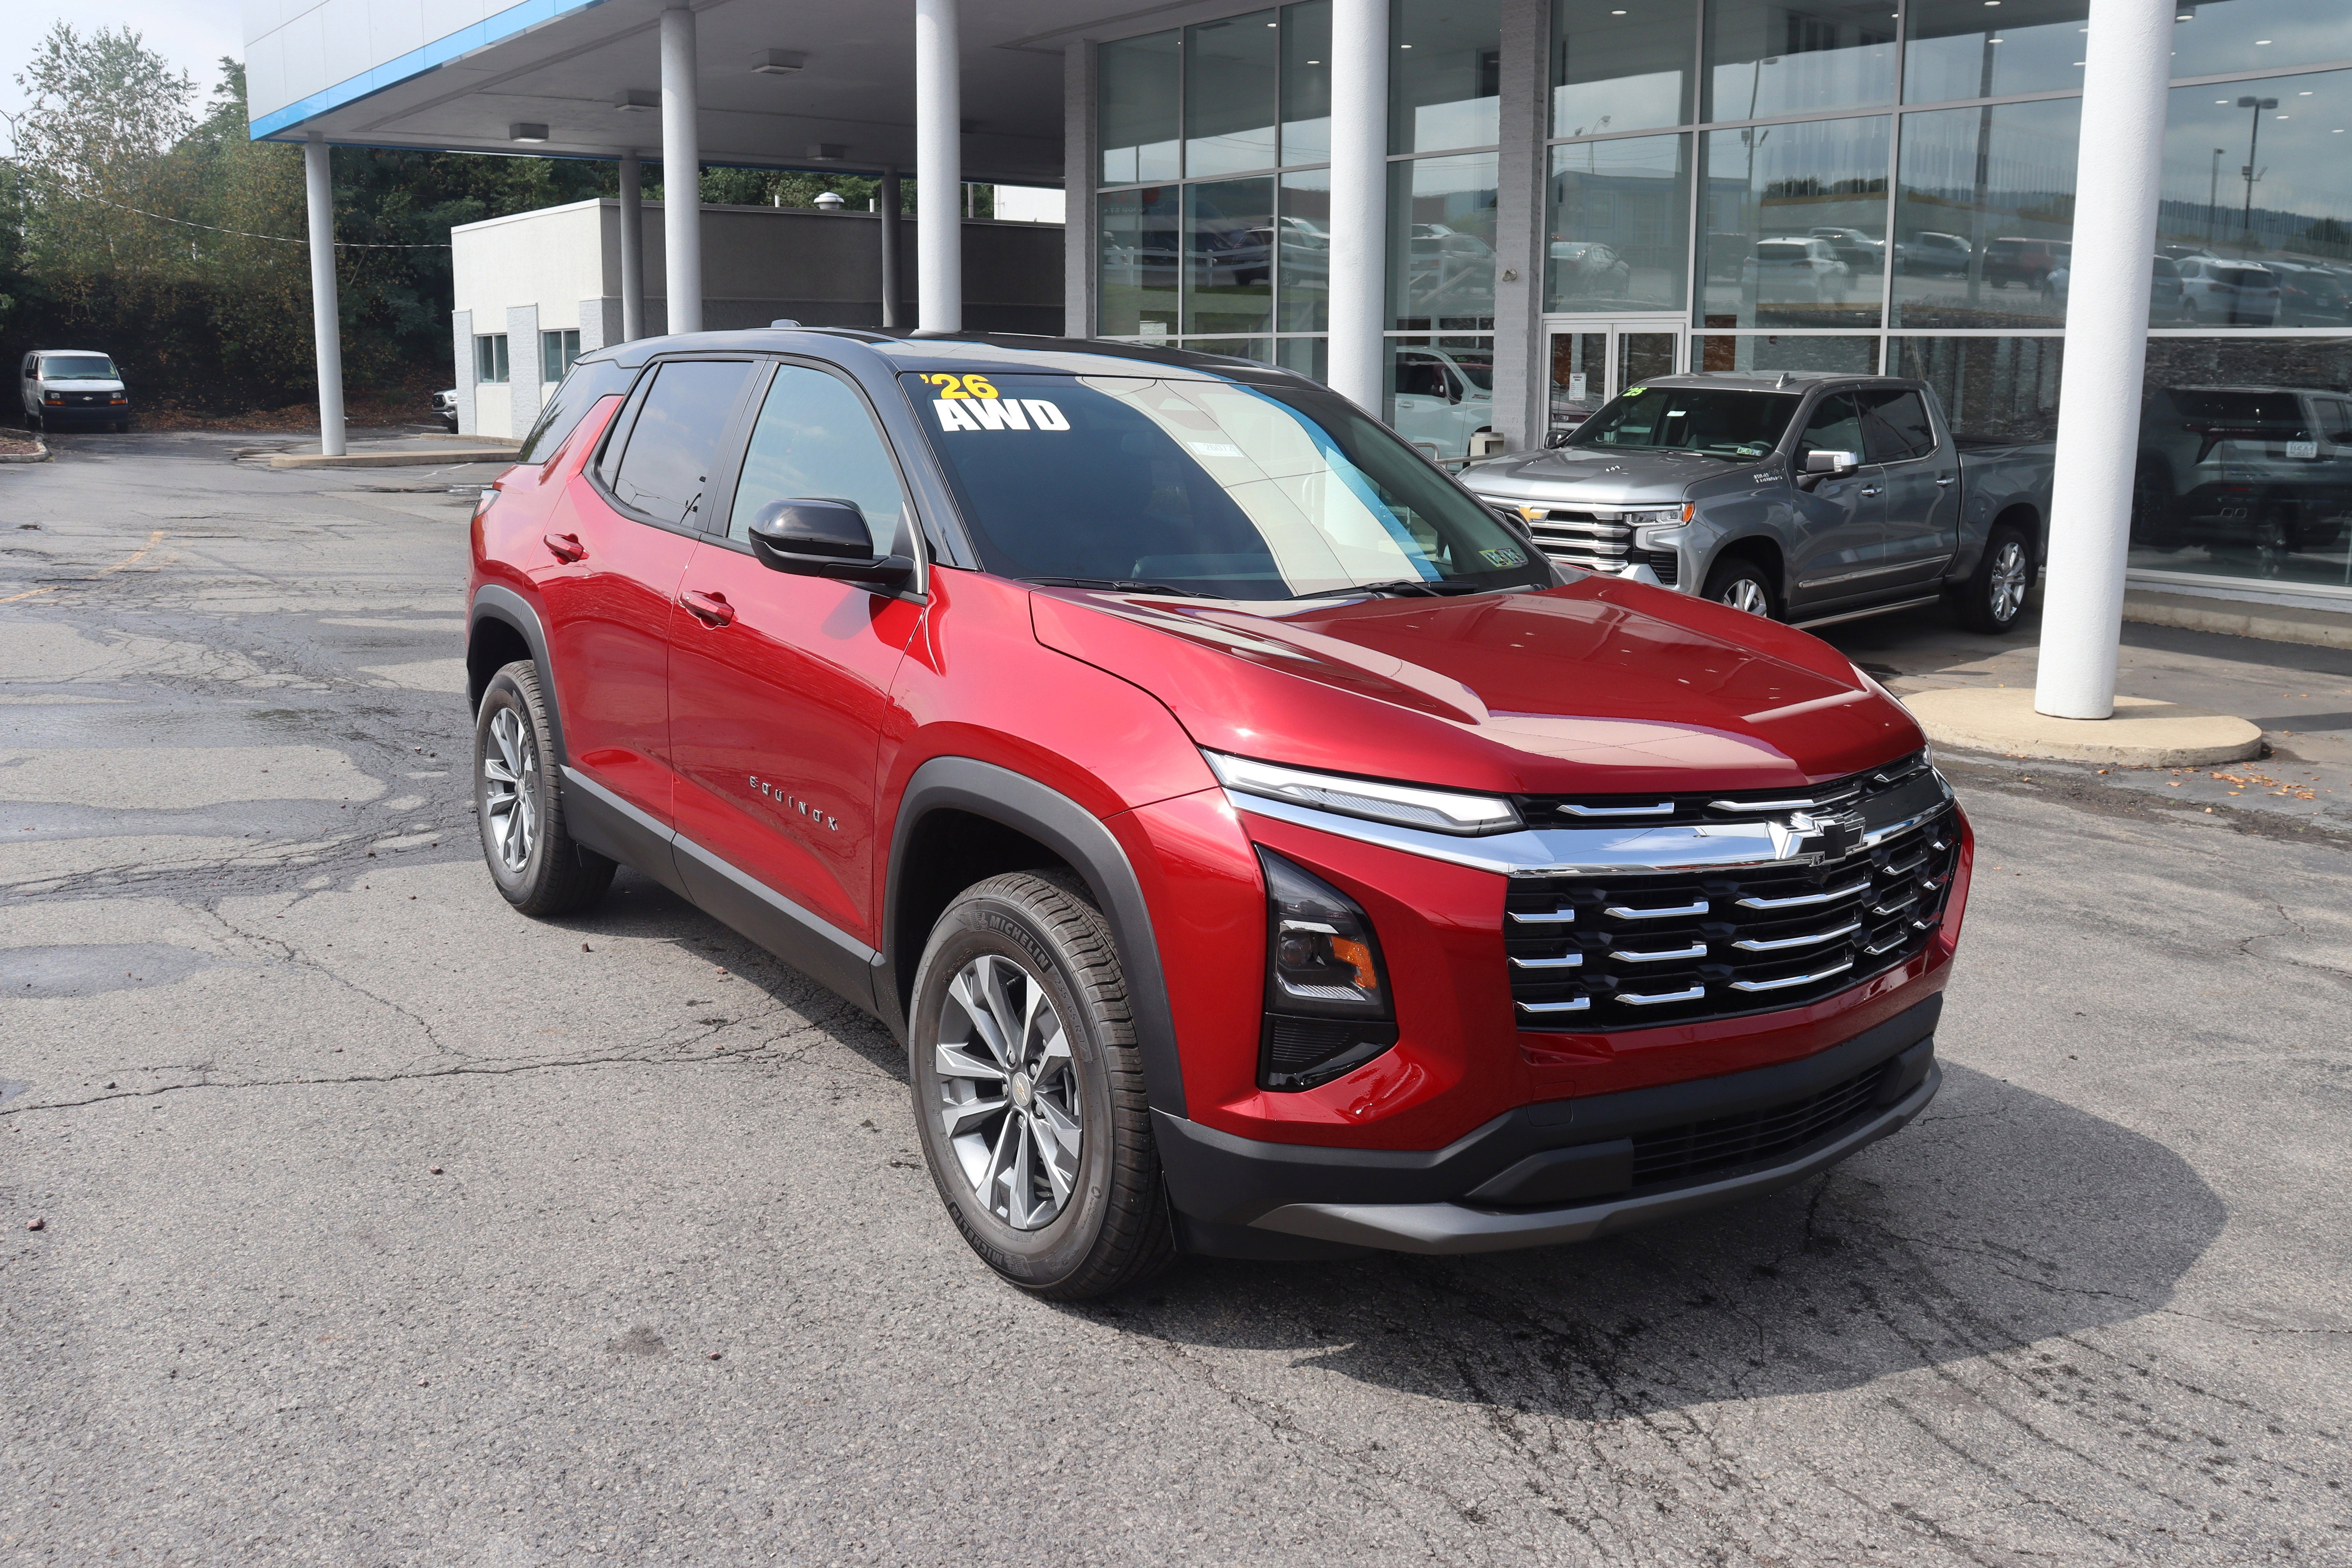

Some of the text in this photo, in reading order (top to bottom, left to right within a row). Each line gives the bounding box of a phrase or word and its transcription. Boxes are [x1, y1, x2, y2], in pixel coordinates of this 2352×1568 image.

[920, 374, 998, 399] '26
[932, 399, 1071, 431] AWD
[520, 710, 537, 768] MICHELIN
[749, 775, 838, 831] EQUINOX
[990, 915, 1049, 968] MICHELIN
[1054, 978, 1077, 1020] 235/65
[951, 1206, 1003, 1264] MICHELIN
